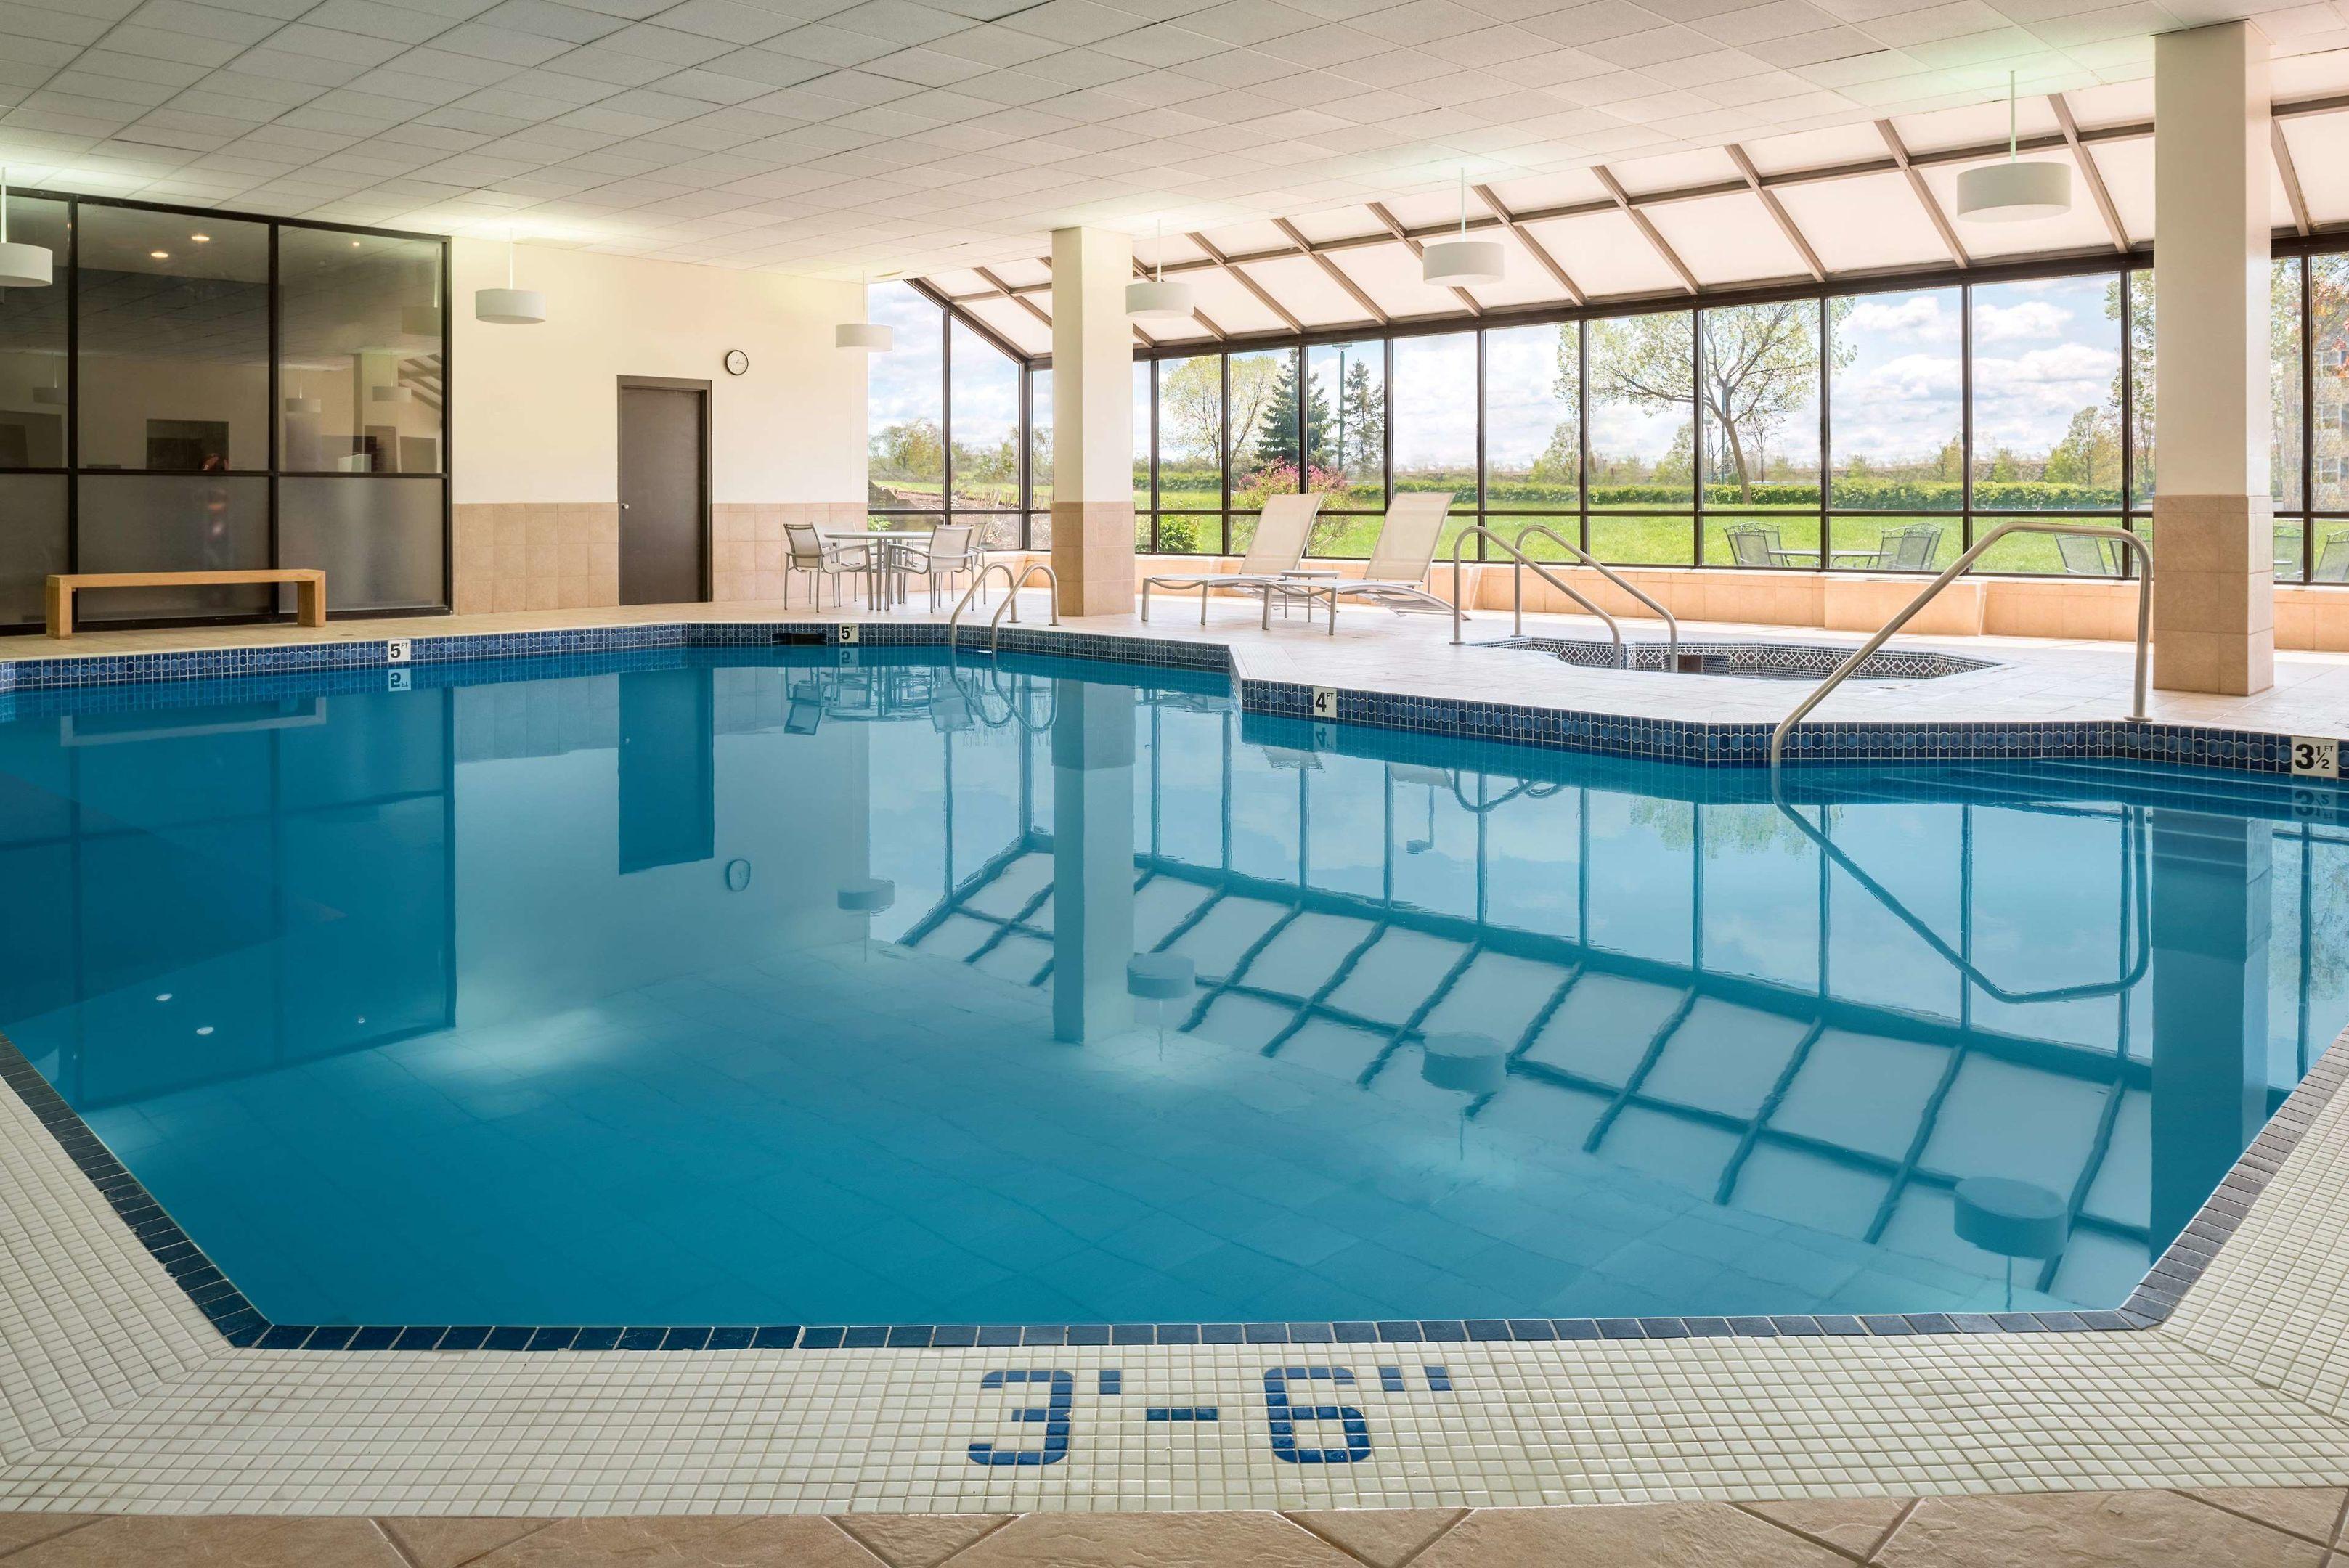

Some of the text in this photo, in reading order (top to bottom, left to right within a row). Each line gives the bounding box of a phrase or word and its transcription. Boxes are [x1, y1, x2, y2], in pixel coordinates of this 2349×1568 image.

[841, 626, 850, 640] 5
[390, 643, 401, 658] 5
[1315, 692, 1327, 712] 4
